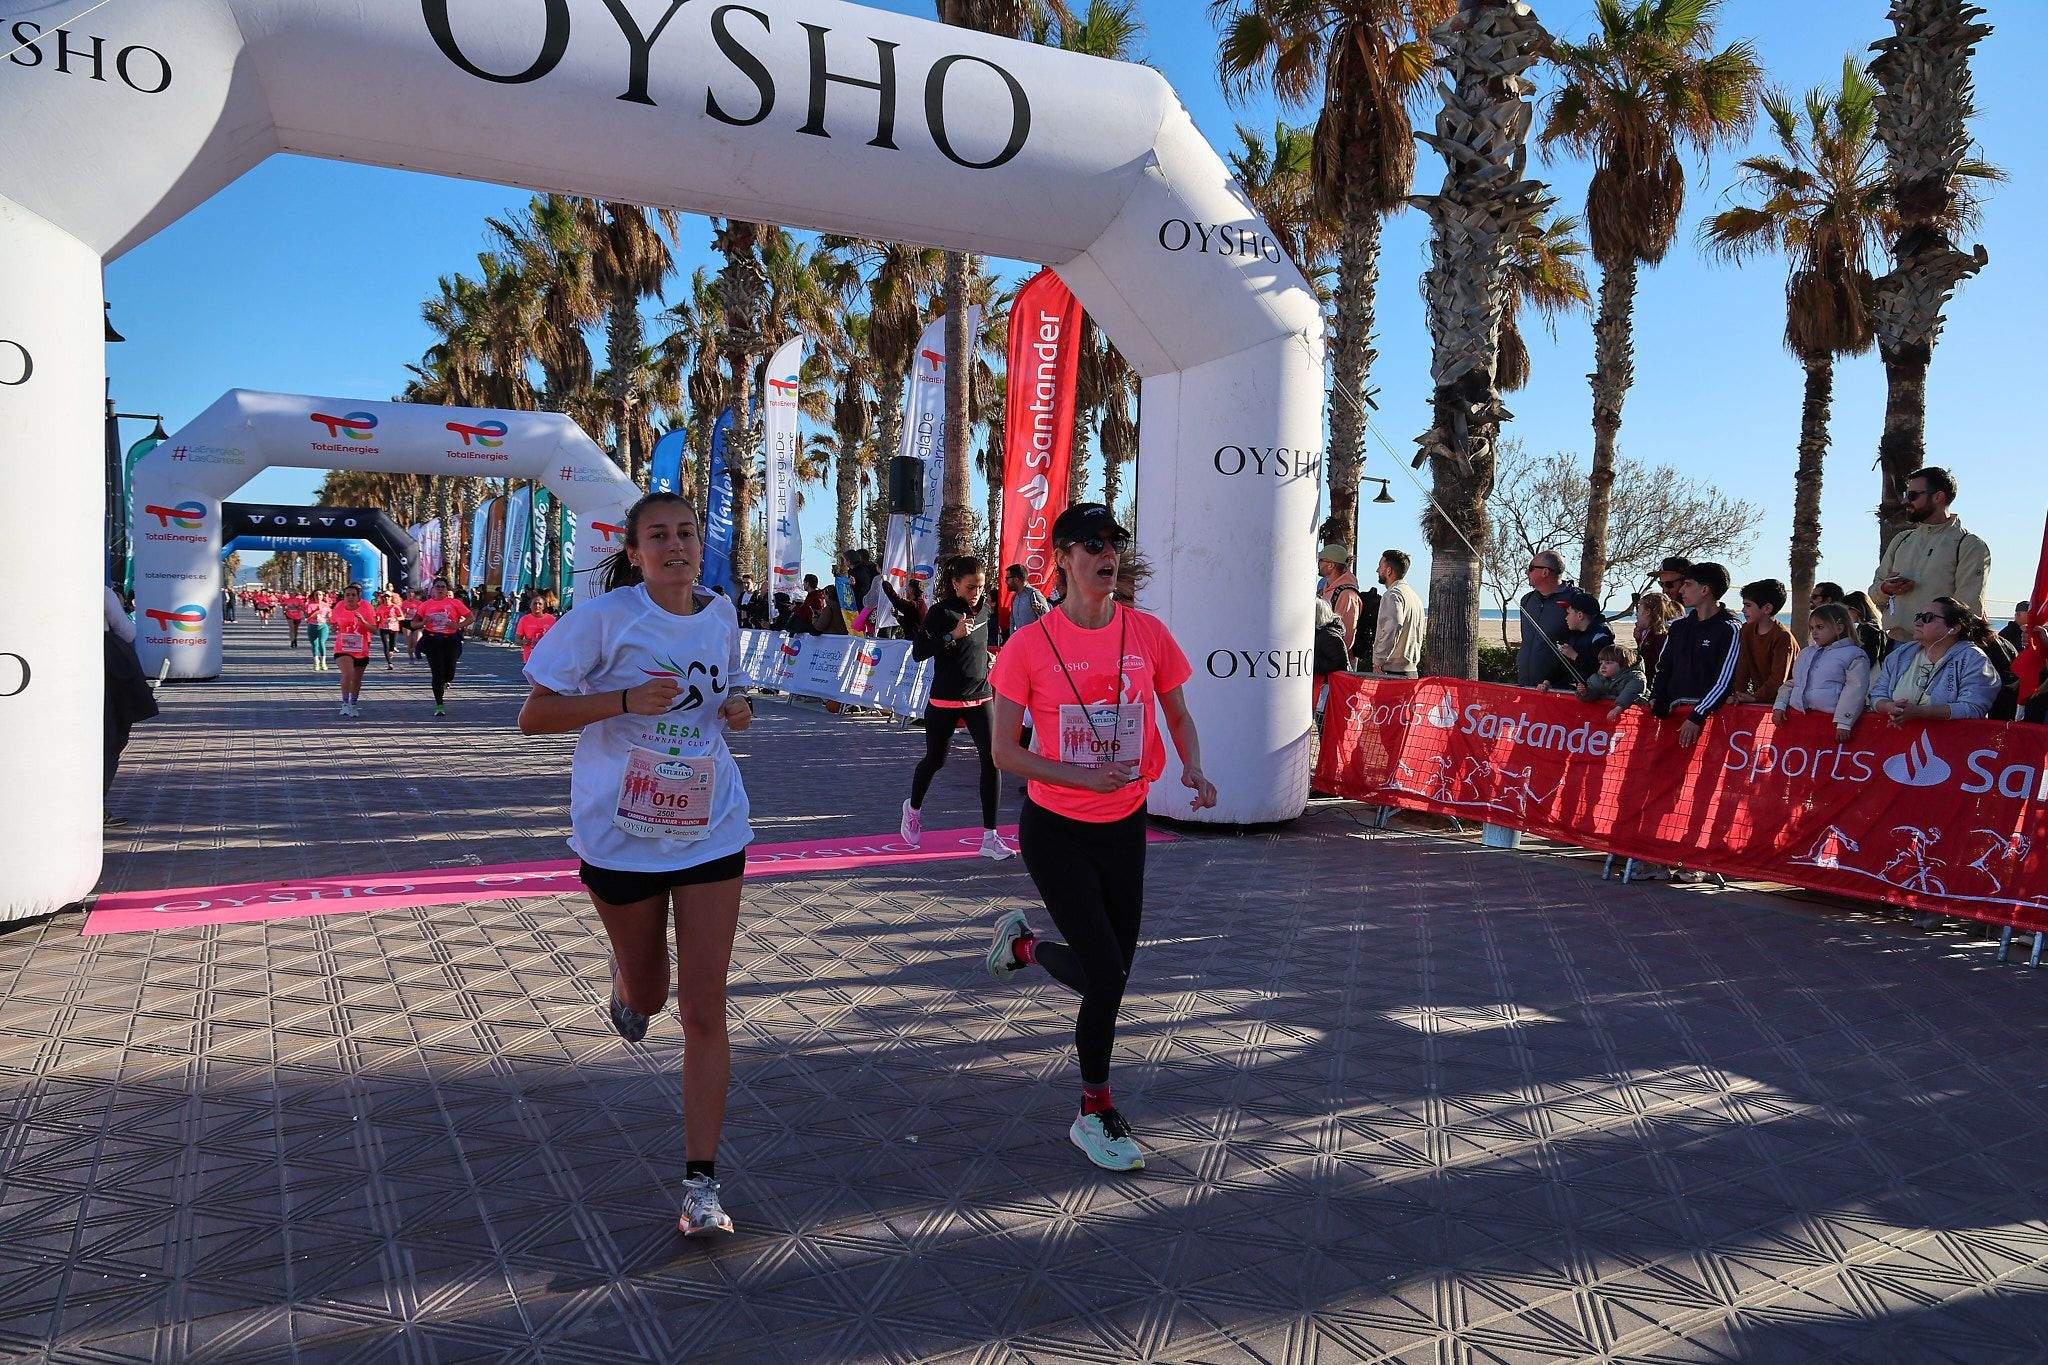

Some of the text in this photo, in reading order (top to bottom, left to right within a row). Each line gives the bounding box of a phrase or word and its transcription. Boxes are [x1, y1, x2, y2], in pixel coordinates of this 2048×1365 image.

[0, 18, 172, 93] SHO
[1158, 219, 1281, 264] OYSHO
[1025, 310, 1060, 469] Santander
[310, 442, 379, 455] TotalEnergies
[445, 450, 509, 462] TotalEnergies
[248, 514, 357, 527] VOLVO
[145, 532, 208, 544] TotalEnergies
[1022, 516, 1047, 588] ports
[145, 636, 207, 647] TotalEnergies
[1054, 661, 1089, 673] OSHO
[656, 721, 701, 738] RESA
[1344, 691, 1625, 756] Sports Santander
[641, 733, 683, 745] RUNNING
[1090, 740, 1121, 753] 016
[1723, 730, 1875, 783] Sports
[657, 766, 692, 778] ASTURIANA
[652, 792, 689, 809] 016
[656, 810, 675, 818] 2508
[623, 821, 654, 833] OYSHO
[152, 884, 415, 912] OYSHO
